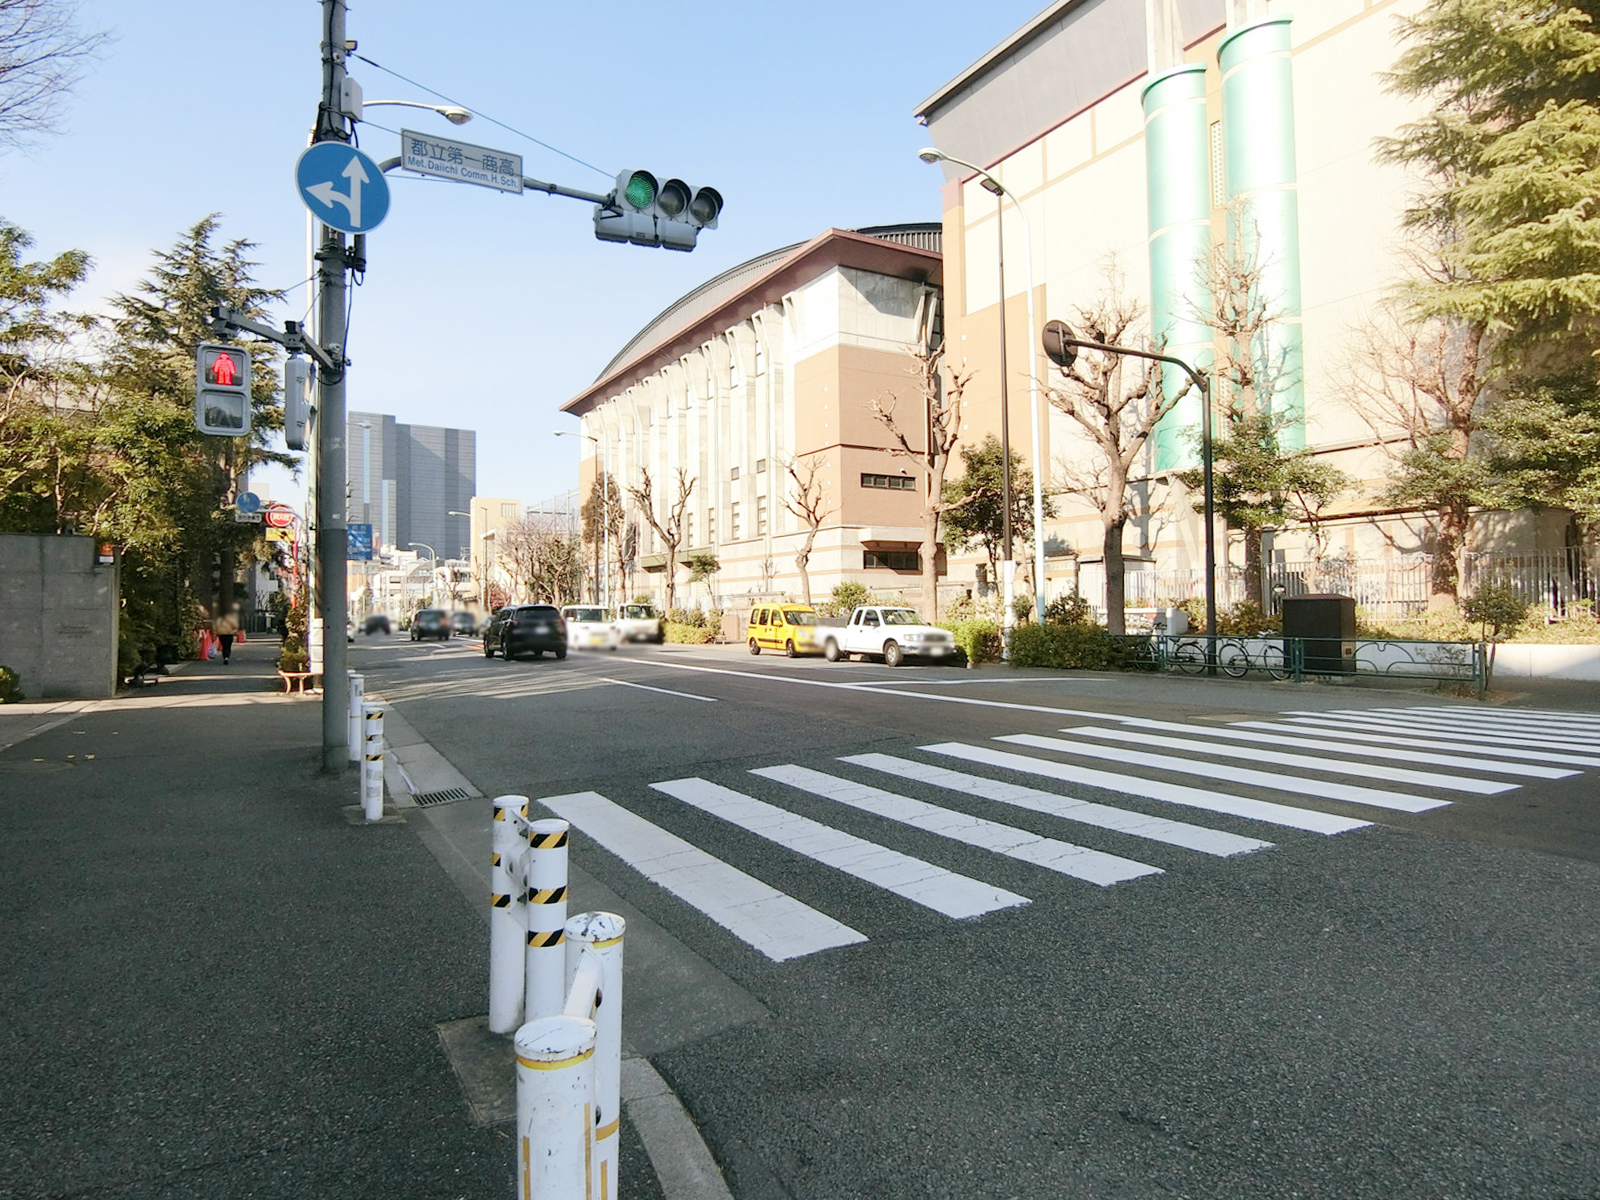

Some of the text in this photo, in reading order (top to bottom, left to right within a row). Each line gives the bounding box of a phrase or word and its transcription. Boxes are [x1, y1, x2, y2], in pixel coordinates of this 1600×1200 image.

[408, 156, 518, 188] Met. Daiichi Comm. H. Sch.
[410, 138, 515, 177] 都立第一商高
